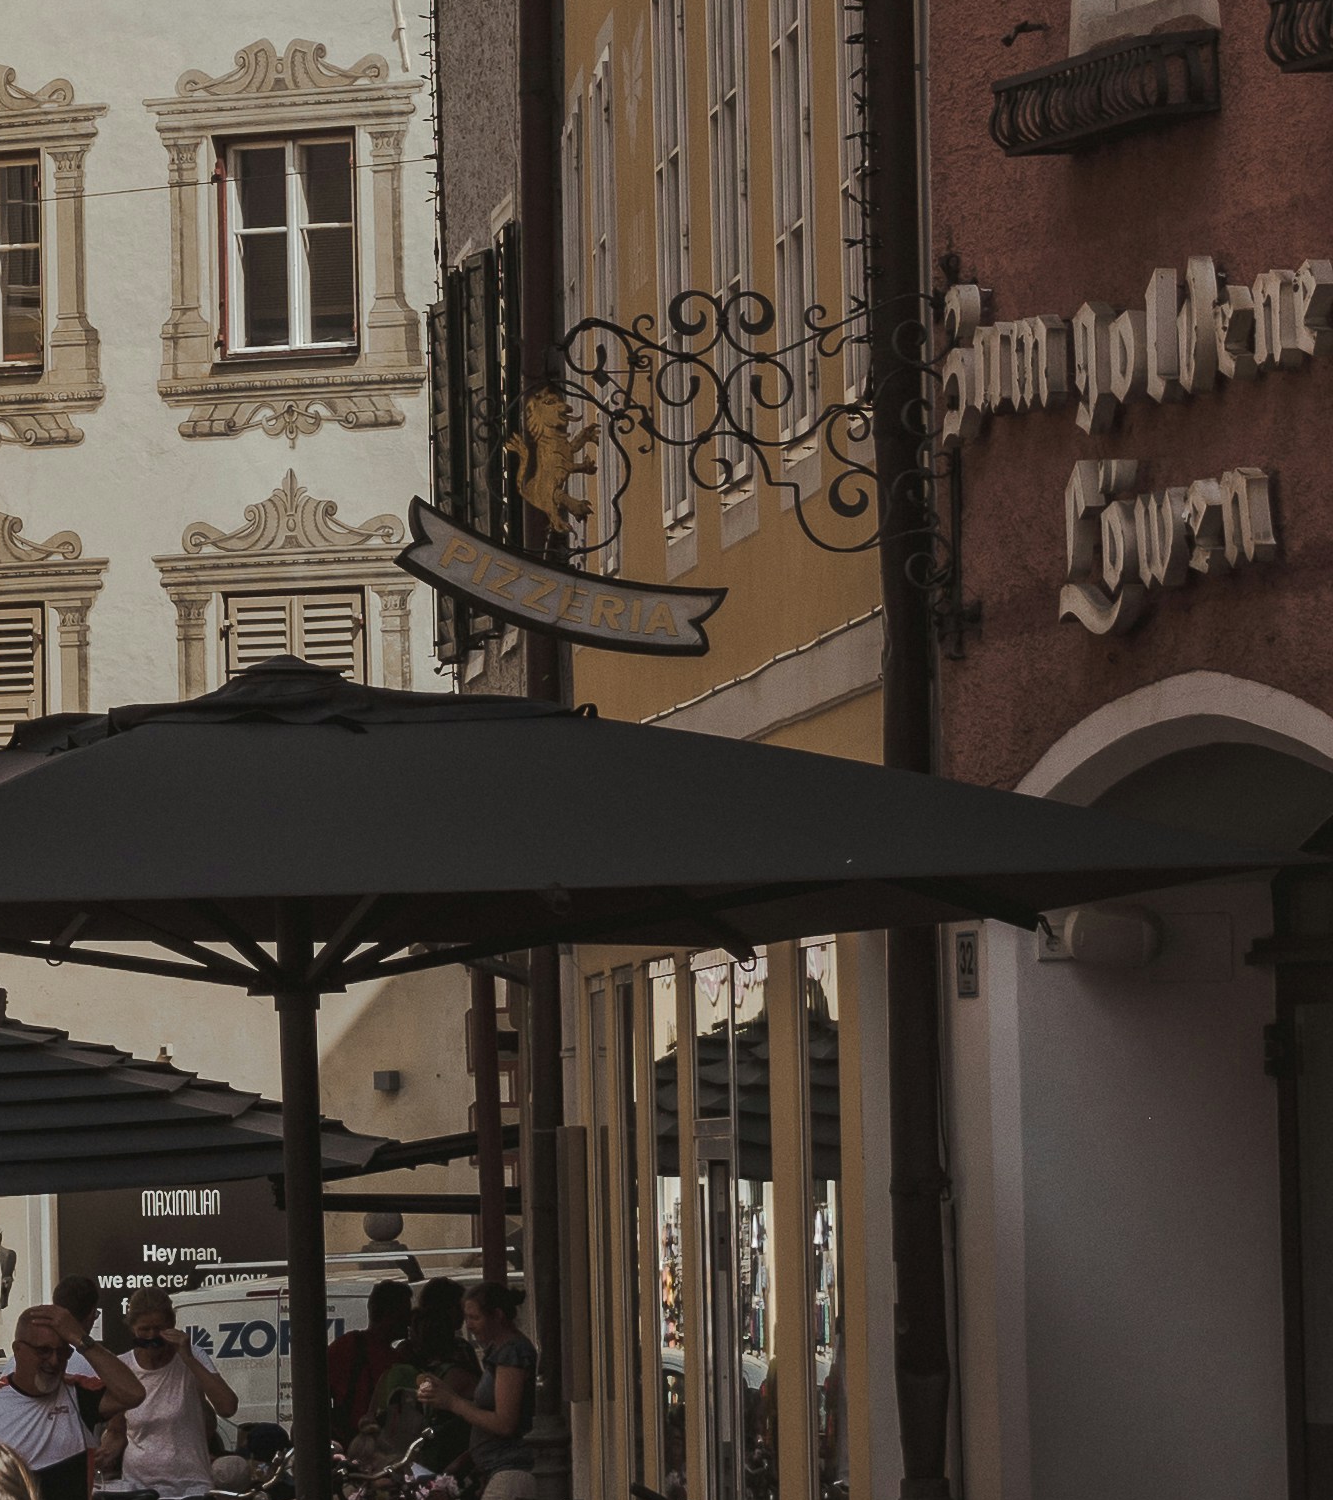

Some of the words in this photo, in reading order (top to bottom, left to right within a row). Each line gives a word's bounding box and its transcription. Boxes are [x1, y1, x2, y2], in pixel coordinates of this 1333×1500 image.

[438, 537, 680, 637] PIZZERIA
[959, 941, 974, 975] 32
[142, 1190, 221, 1217] MAXIMILIAN
[143, 1244, 178, 1266] Hey
[180, 1248, 222, 1264] man,
[98, 1275, 124, 1289] we
[126, 1275, 152, 1289] are
